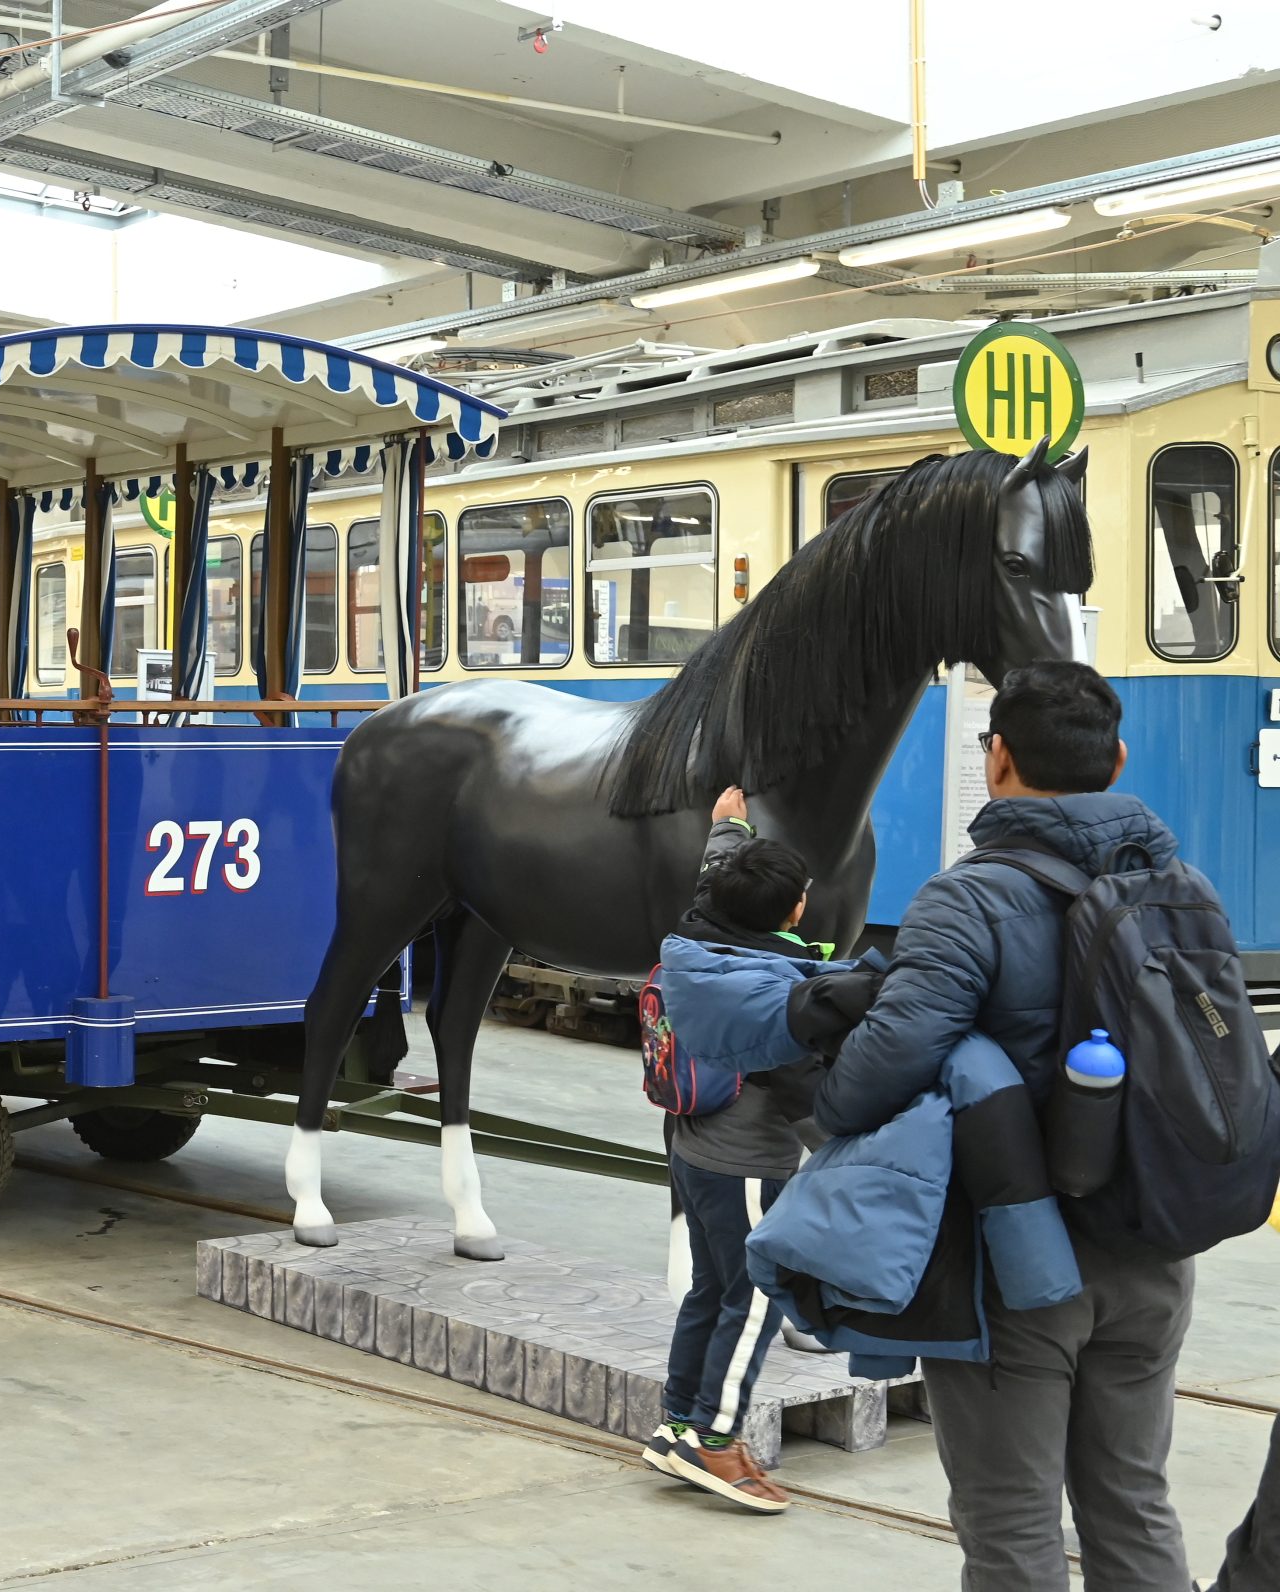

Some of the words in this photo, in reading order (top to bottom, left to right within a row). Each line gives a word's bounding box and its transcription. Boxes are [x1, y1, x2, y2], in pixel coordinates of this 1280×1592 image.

[986, 351, 1052, 440] HH
[144, 818, 261, 897] 273
[1195, 991, 1231, 1039] SIGG
